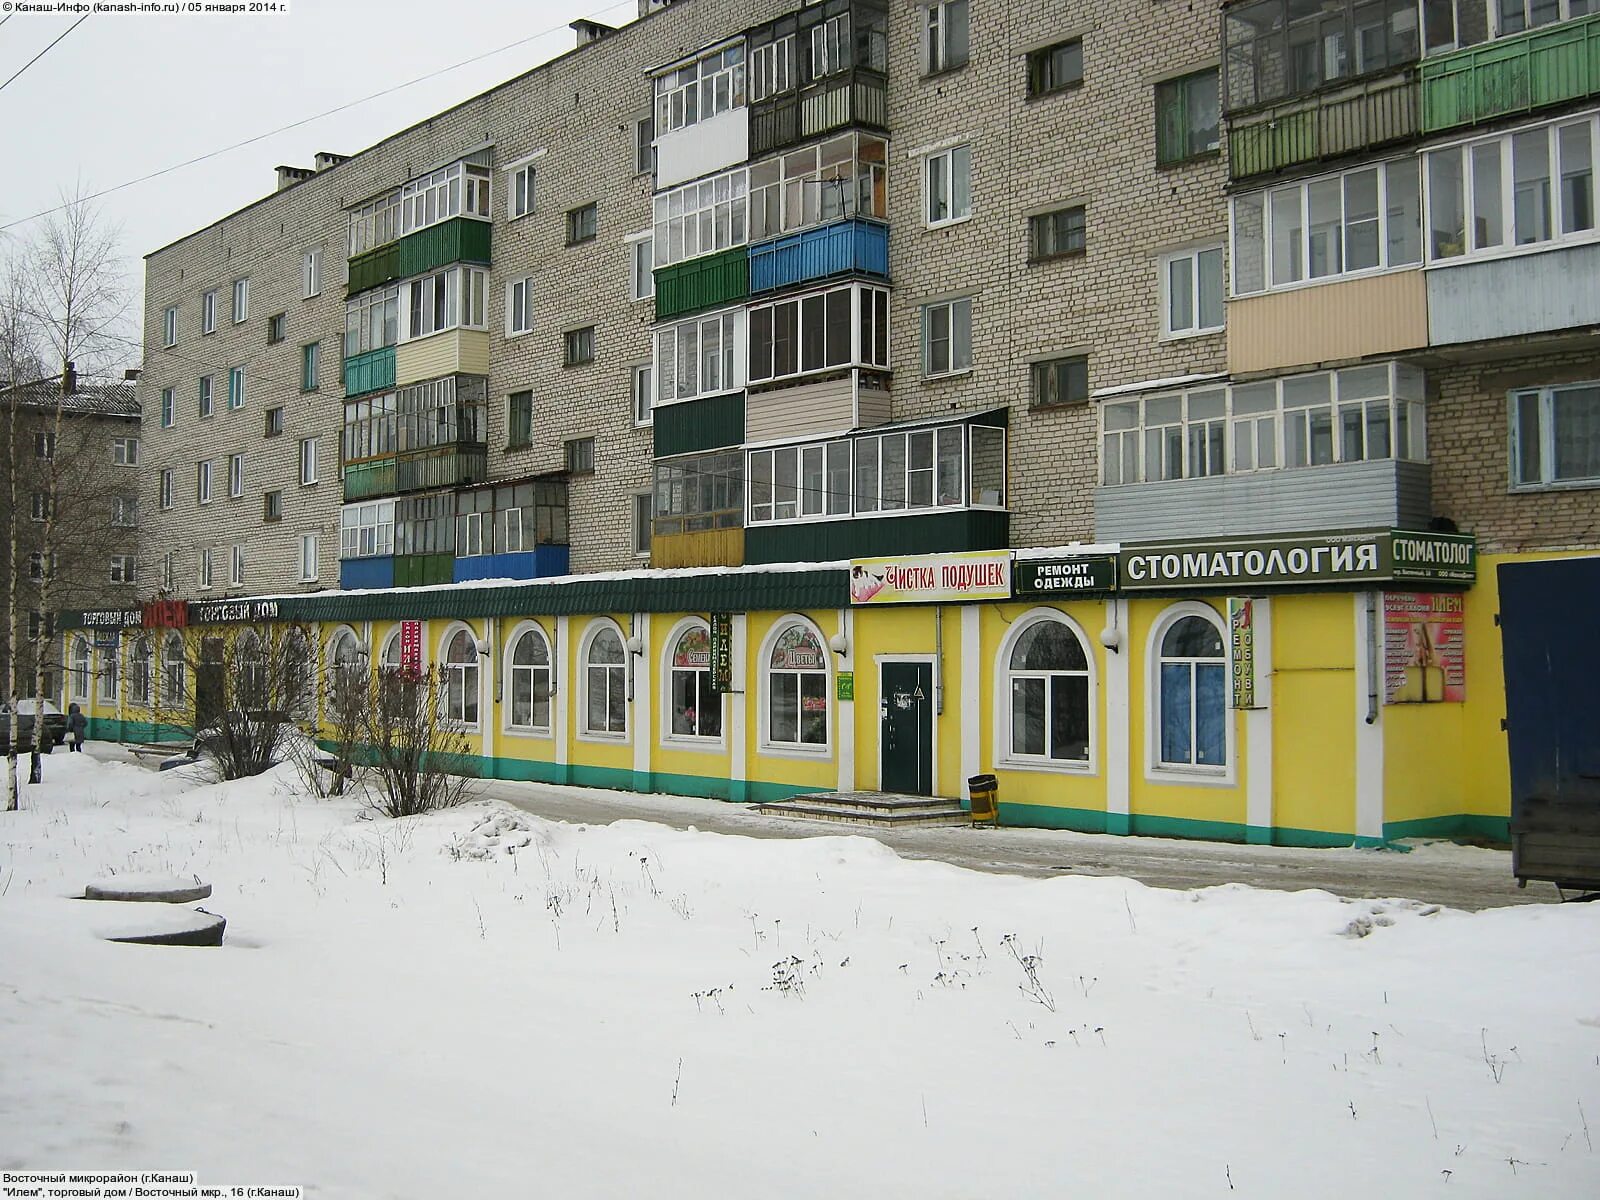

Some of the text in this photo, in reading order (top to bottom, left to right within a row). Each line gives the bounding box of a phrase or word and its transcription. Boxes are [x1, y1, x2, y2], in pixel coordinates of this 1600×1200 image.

[1127, 543, 1378, 580] СТОМАТОЛОГИЯ
[1392, 539, 1474, 564] СТОМАТОЛОГ
[942, 561, 1004, 590] ПОДУШЕК
[1034, 576, 1095, 589] ОДЕЖДЫ
[1037, 564, 1089, 577] РЕМОНТ
[83, 608, 142, 627] ТОРГОВЫЙ ДОМ
[200, 601, 278, 622] ТОРГОВЫЙ ДОМ
[719, 623, 729, 682] ИЛЕМ
[1232, 619, 1242, 704] РЕМОНТ
[1244, 634, 1252, 704] ОБУВИ
